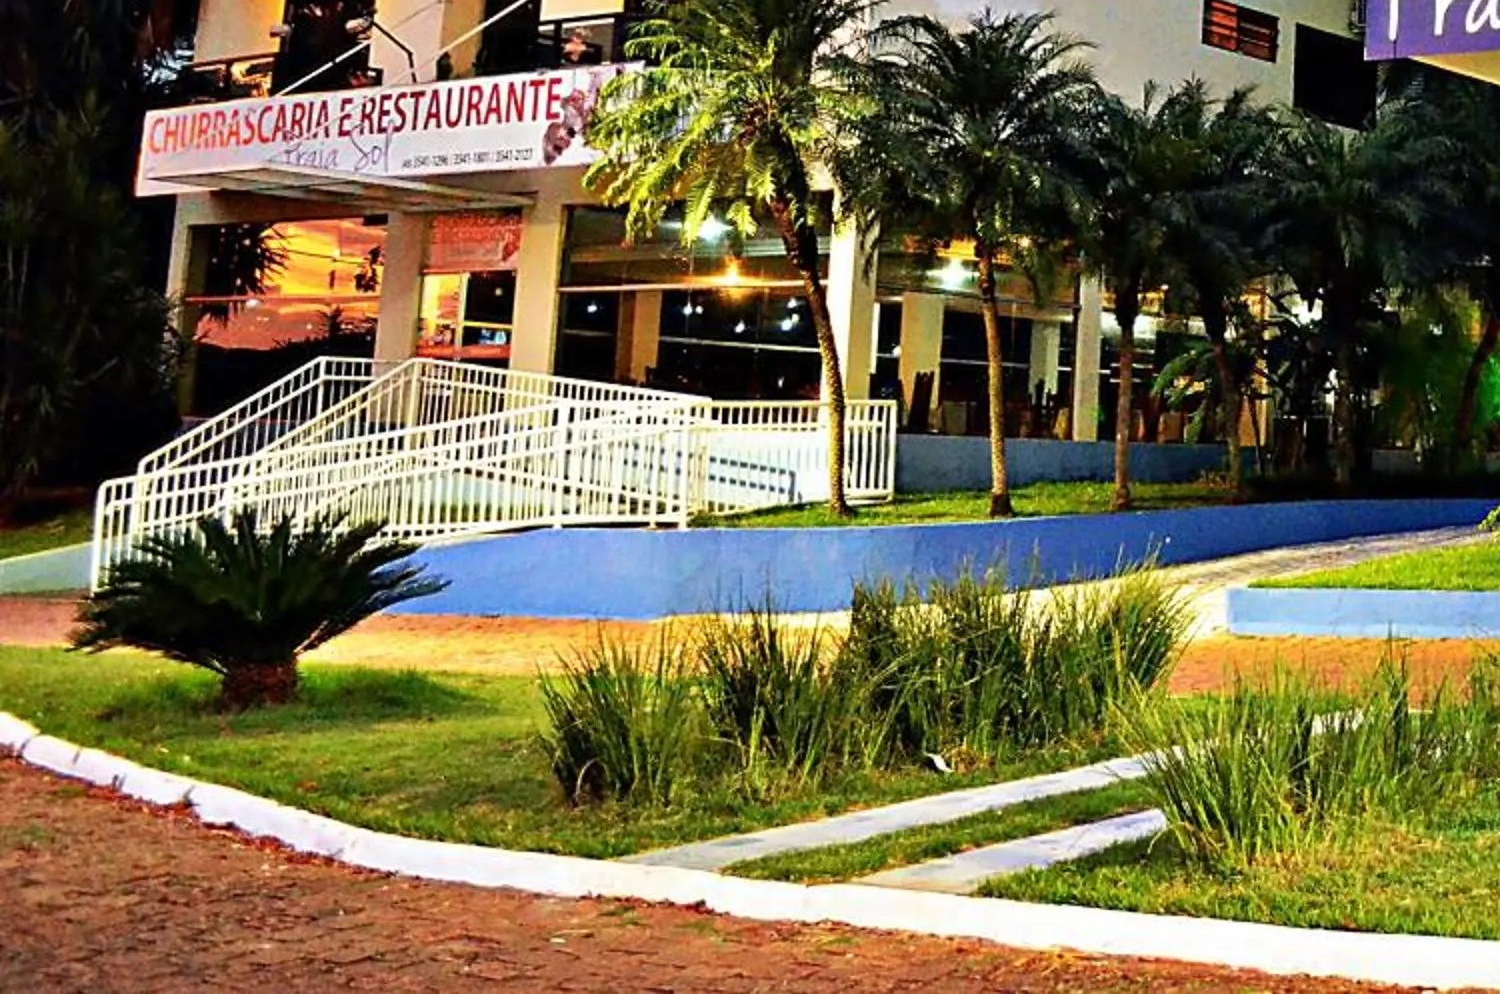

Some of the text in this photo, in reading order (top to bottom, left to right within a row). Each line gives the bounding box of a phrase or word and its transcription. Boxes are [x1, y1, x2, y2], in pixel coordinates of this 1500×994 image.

[148, 77, 563, 155] CHURRASCARIA E RESTAURANTE
[350, 119, 396, 173] Sol
